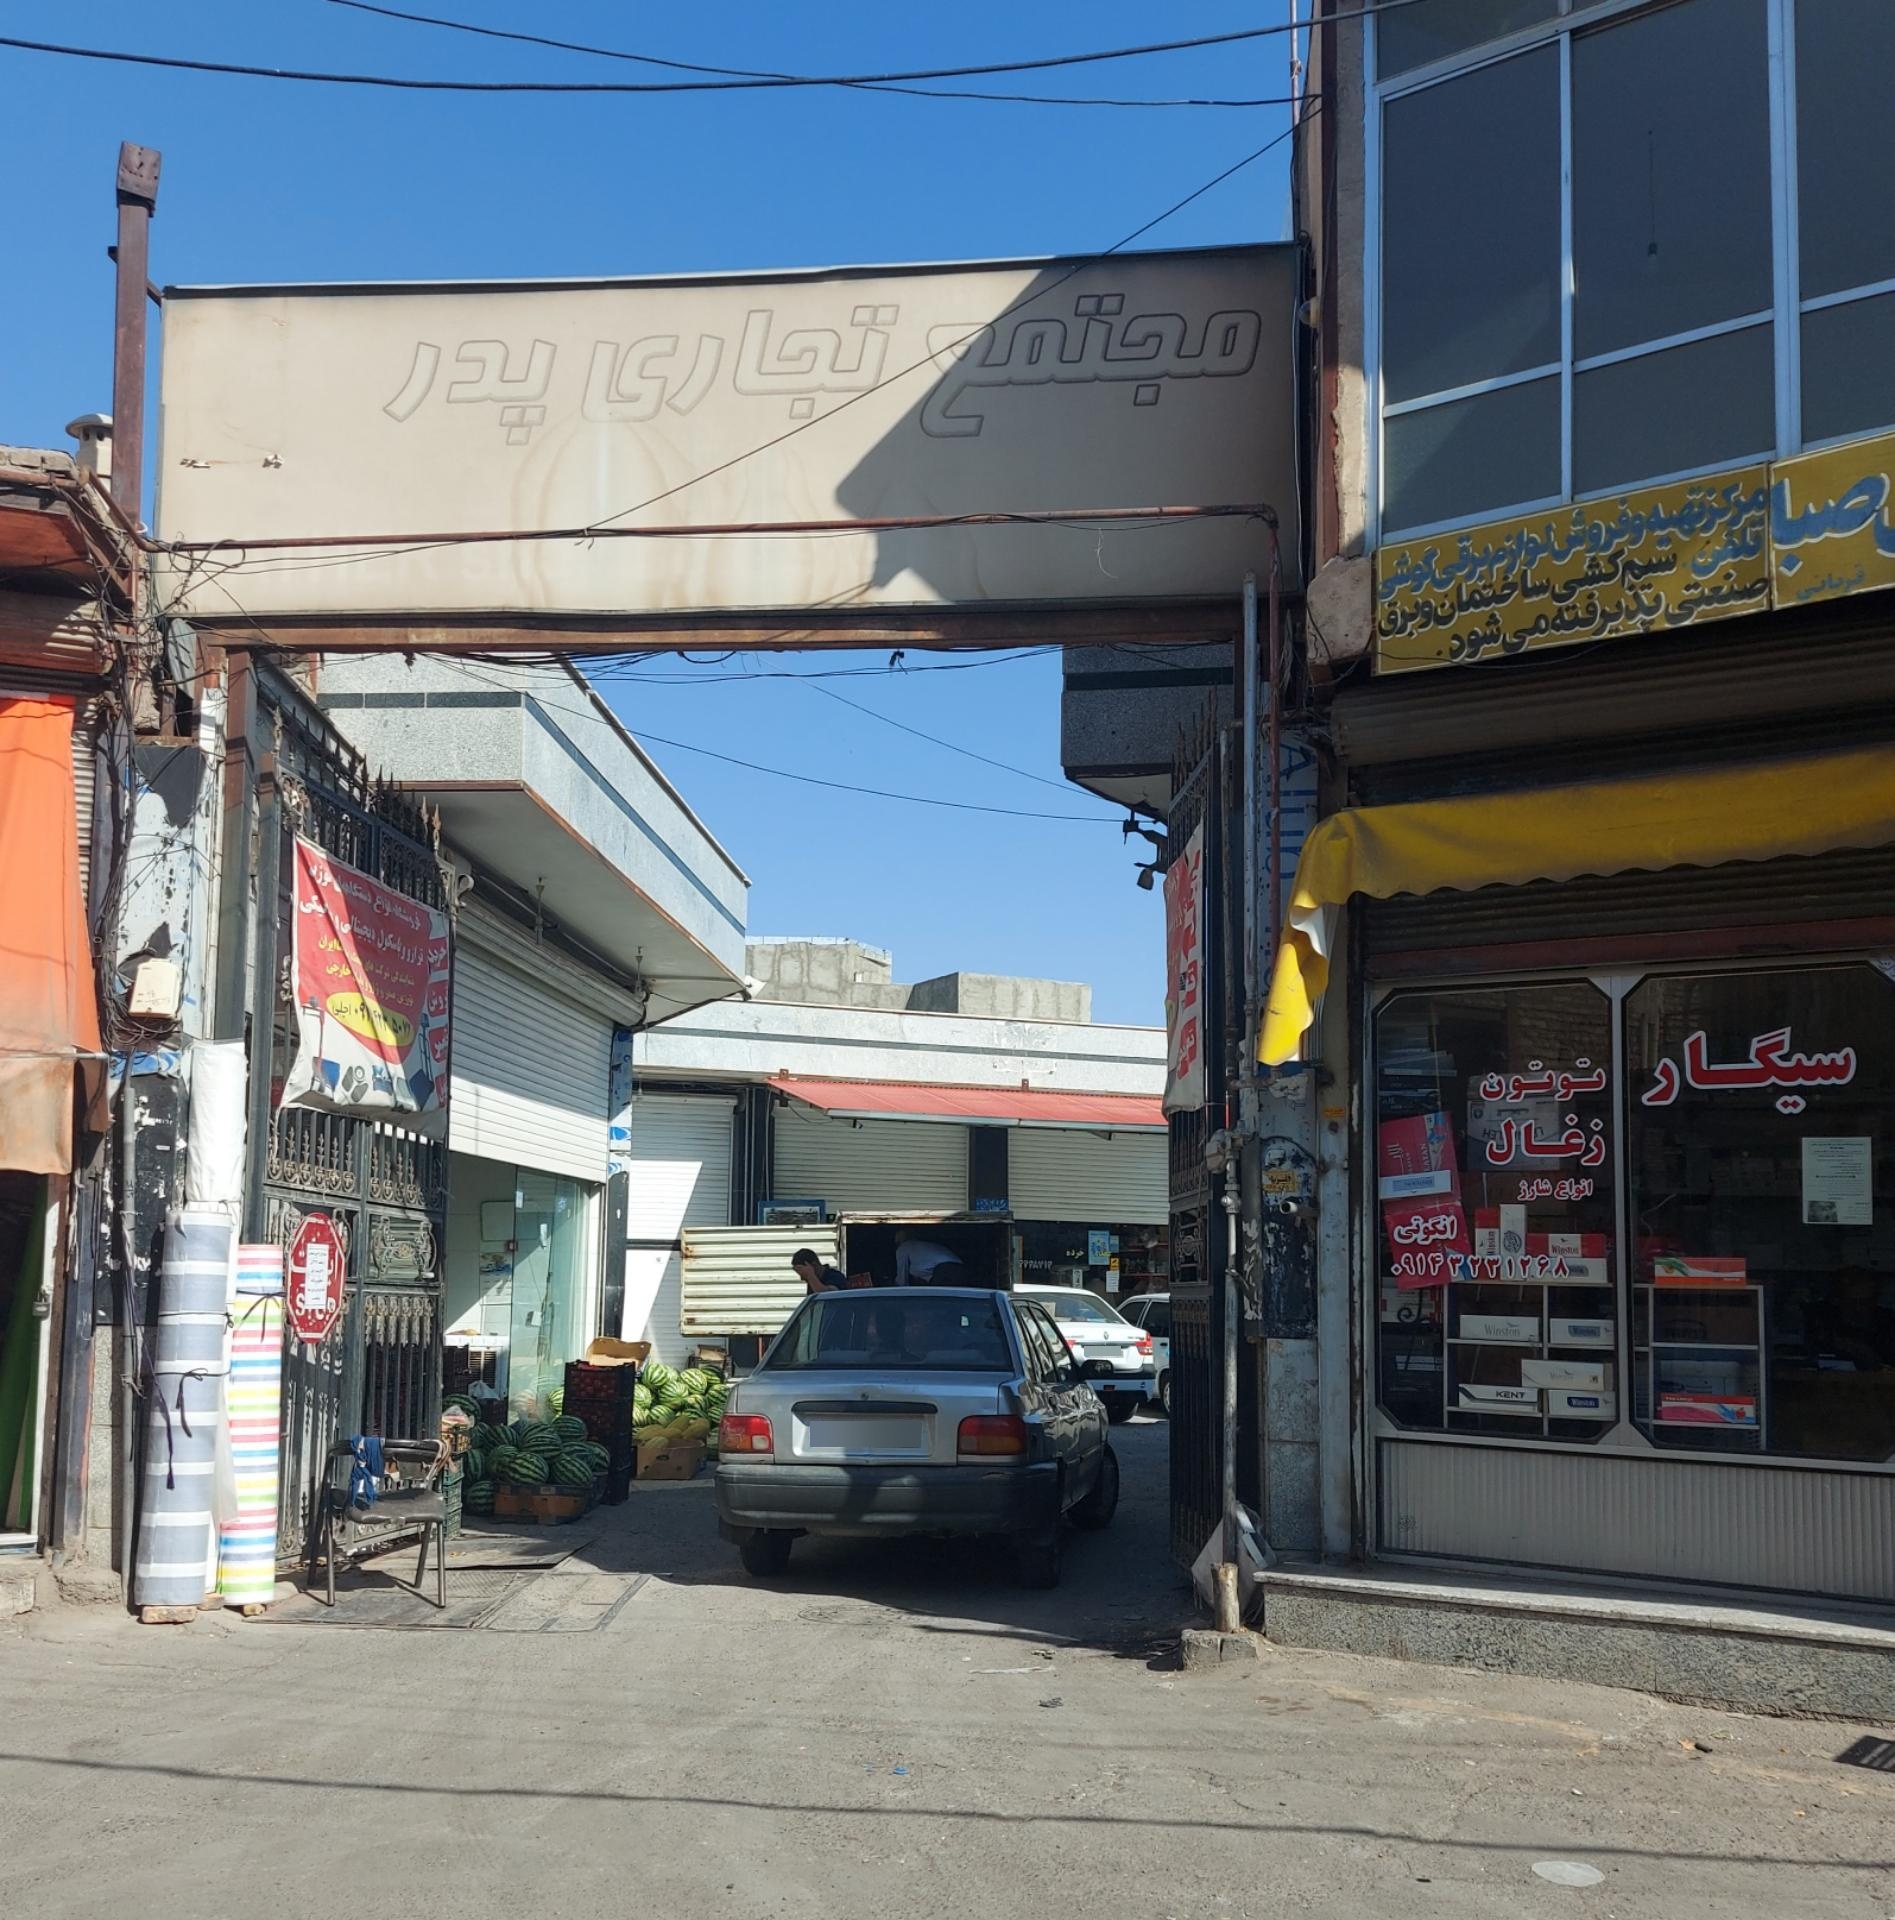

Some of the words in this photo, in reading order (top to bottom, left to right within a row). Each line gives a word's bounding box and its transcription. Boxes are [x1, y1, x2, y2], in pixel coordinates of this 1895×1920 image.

[581, 304, 899, 422] تجاری
[920, 294, 1262, 437] مجتمع
[383, 339, 557, 445] پدر
[1552, 497, 1632, 566] فروش
[1646, 486, 1709, 551] تهیه
[1700, 481, 1768, 537] مرکز
[1690, 518, 1766, 580] تلفن
[1432, 567, 1551, 629] ساختمان
[1549, 583, 1665, 639] پذیرفته
[1663, 568, 1769, 626] صنعتی
[1501, 612, 1551, 653] می
[1479, 1058, 1607, 1101] توتون
[1642, 1027, 1857, 1114] سیگار
[1485, 1115, 1606, 1166] زغال
[1517, 1178, 1553, 1202] شارژ
[1553, 1178, 1593, 1201] انواع
[1484, 1323, 1520, 1337] Winston
[1495, 1390, 1526, 1400] KENT
